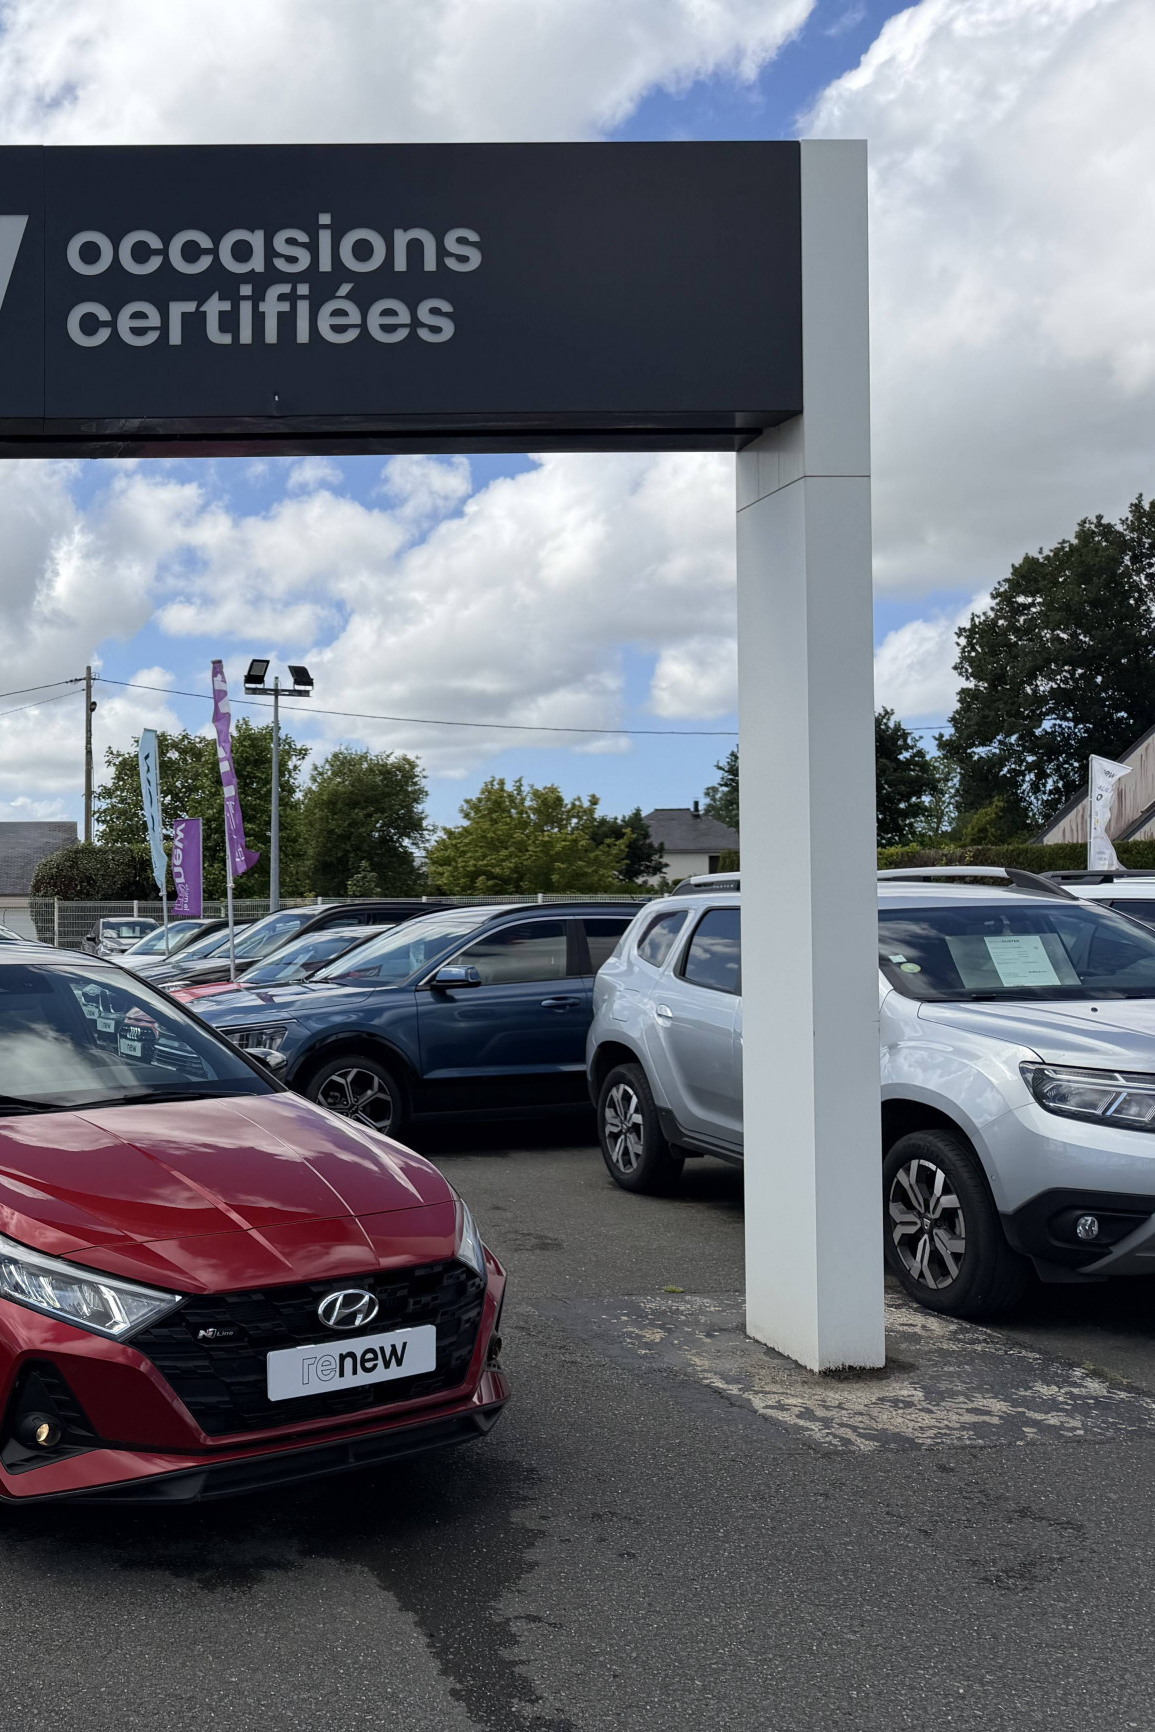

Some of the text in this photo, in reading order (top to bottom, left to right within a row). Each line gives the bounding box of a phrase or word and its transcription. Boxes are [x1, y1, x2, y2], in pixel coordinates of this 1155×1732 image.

[66, 213, 483, 276] occasions
[66, 282, 456, 348] certifiées
[302, 1341, 408, 1385] renew
